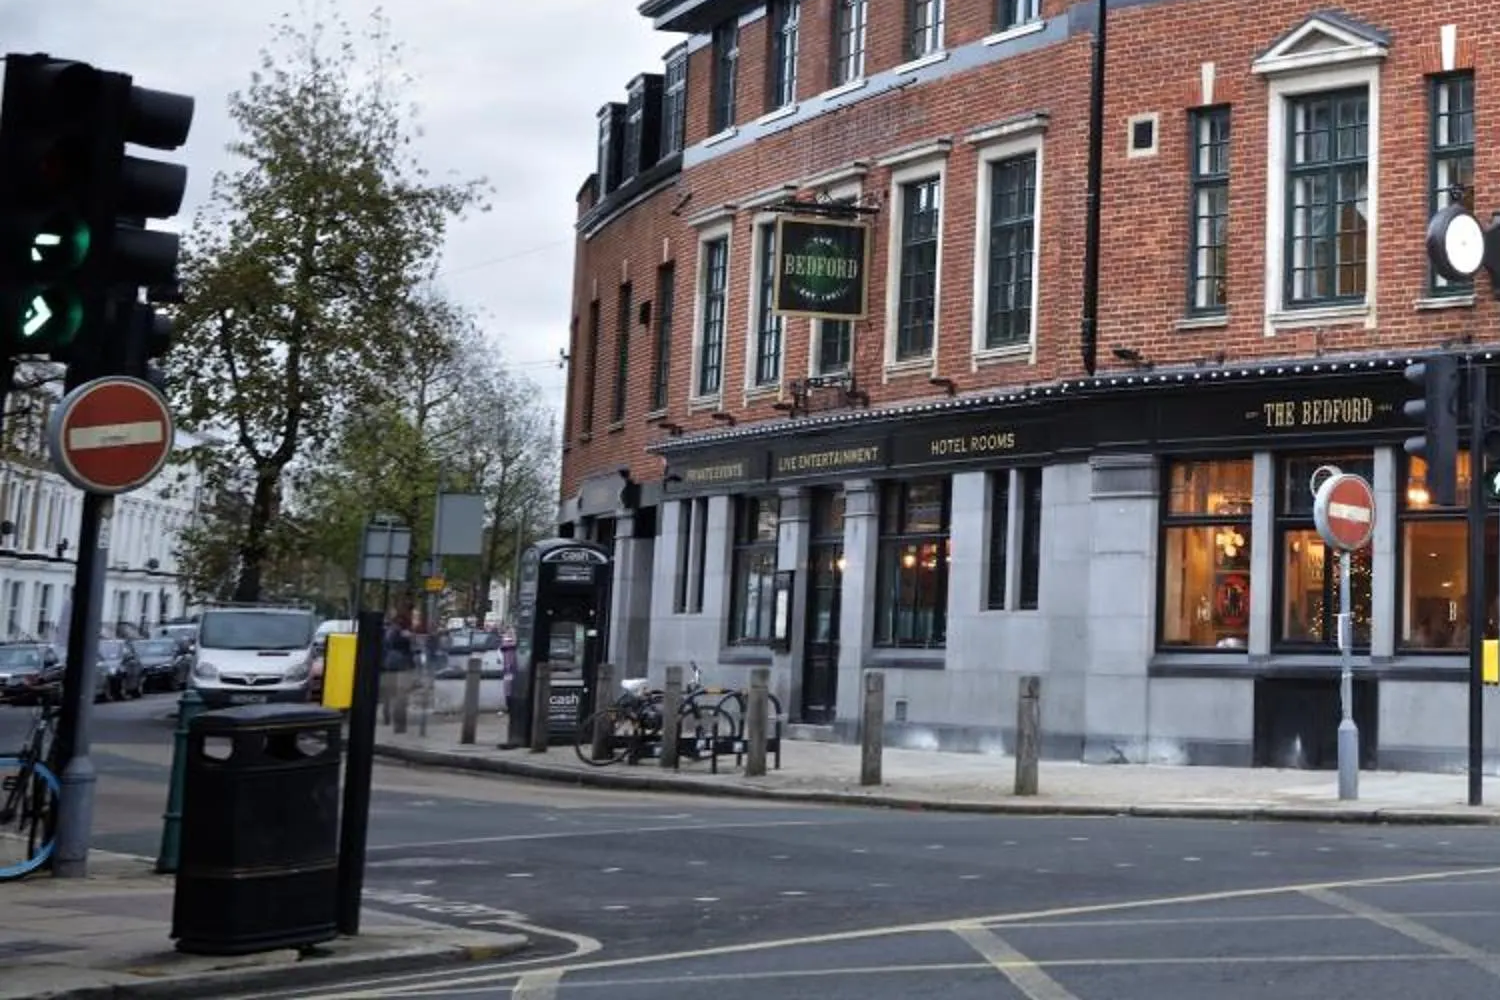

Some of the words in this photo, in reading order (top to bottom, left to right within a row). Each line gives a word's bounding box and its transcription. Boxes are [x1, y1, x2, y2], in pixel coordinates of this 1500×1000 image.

[784, 253, 858, 279] BEDFORD
[1263, 401, 1296, 427] THE
[1302, 397, 1374, 425] BEDFORD
[931, 437, 968, 456] HOTEL
[971, 433, 1016, 451] ROOMS
[778, 456, 797, 472] LIVE
[561, 549, 590, 561] cash
[549, 692, 580, 705] cash
